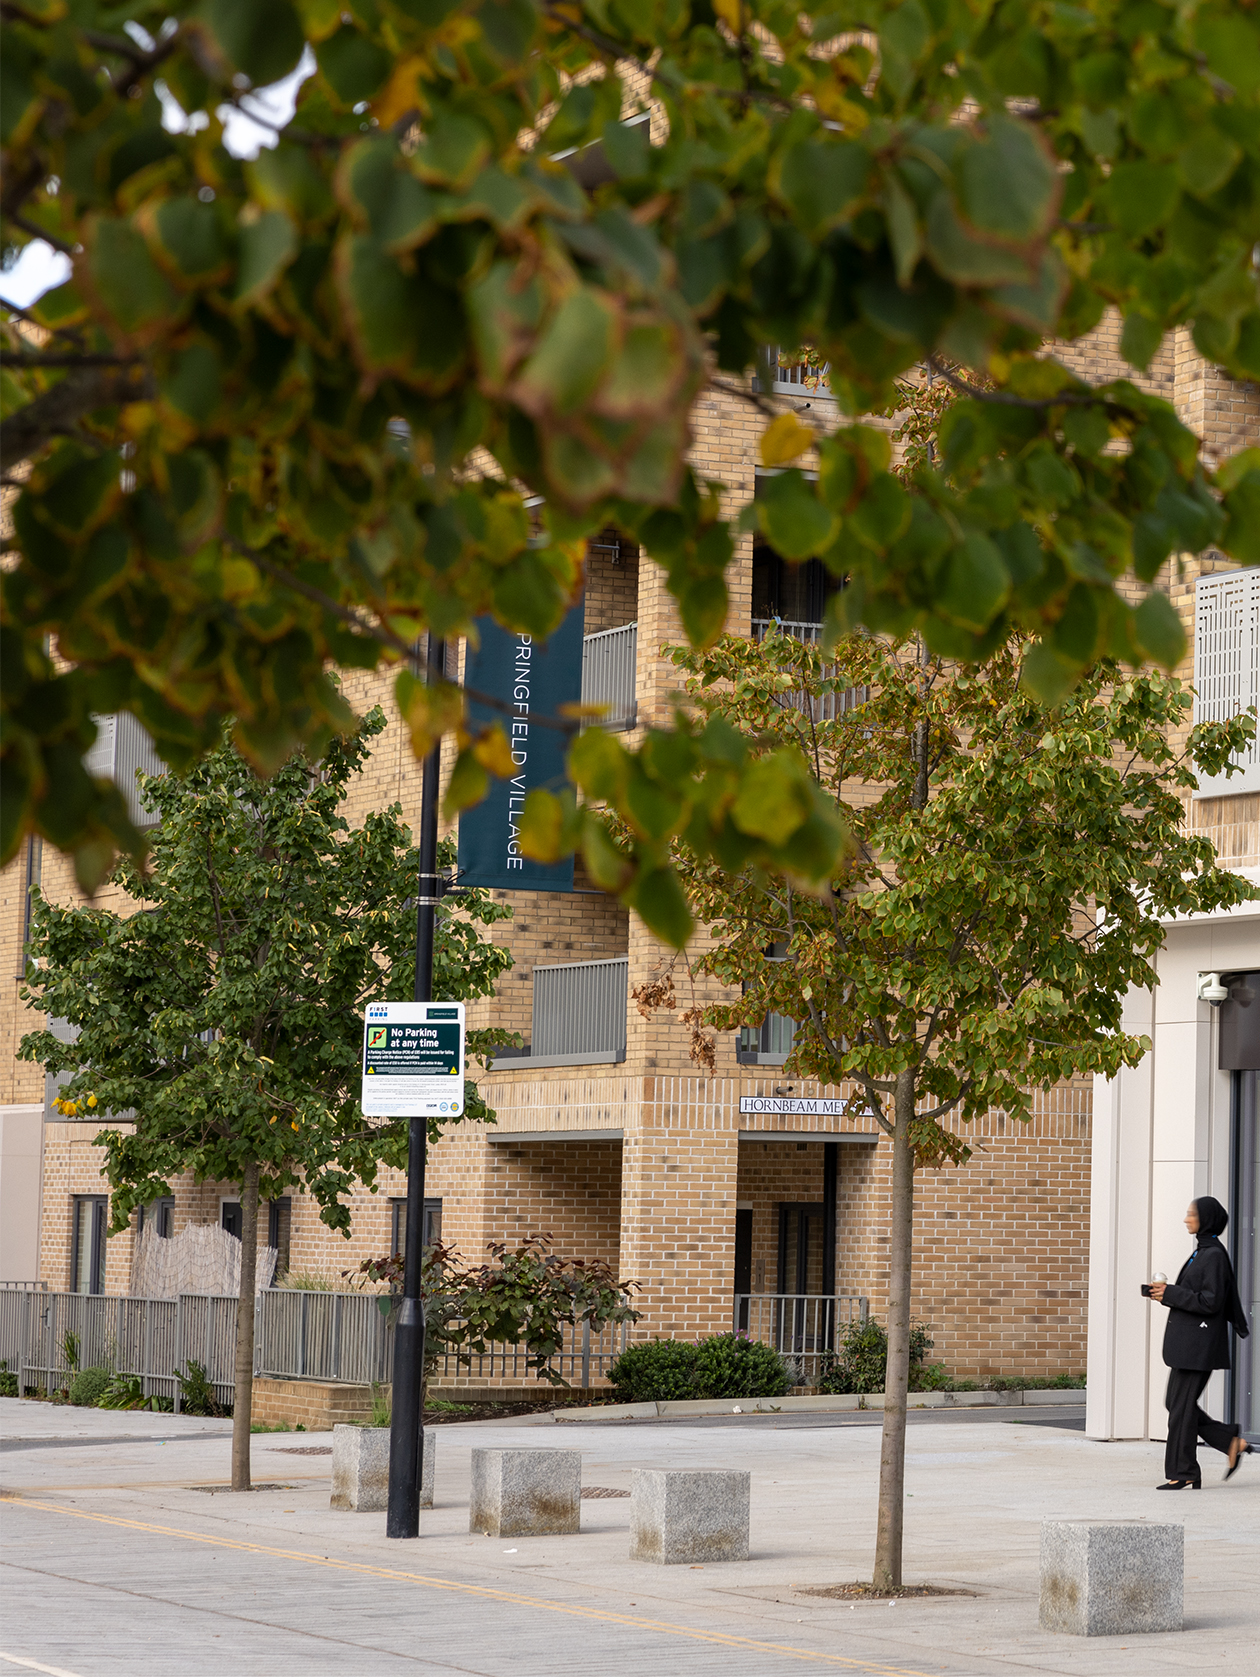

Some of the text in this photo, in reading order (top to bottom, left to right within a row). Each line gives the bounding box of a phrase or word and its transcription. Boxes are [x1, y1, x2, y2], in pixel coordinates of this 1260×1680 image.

[506, 632, 532, 870] PRINGFIELD VILLAGE
[391, 1028, 437, 1039] No Parking
[390, 1039, 439, 1049] at any time
[744, 1099, 818, 1113] HORNBEAM
